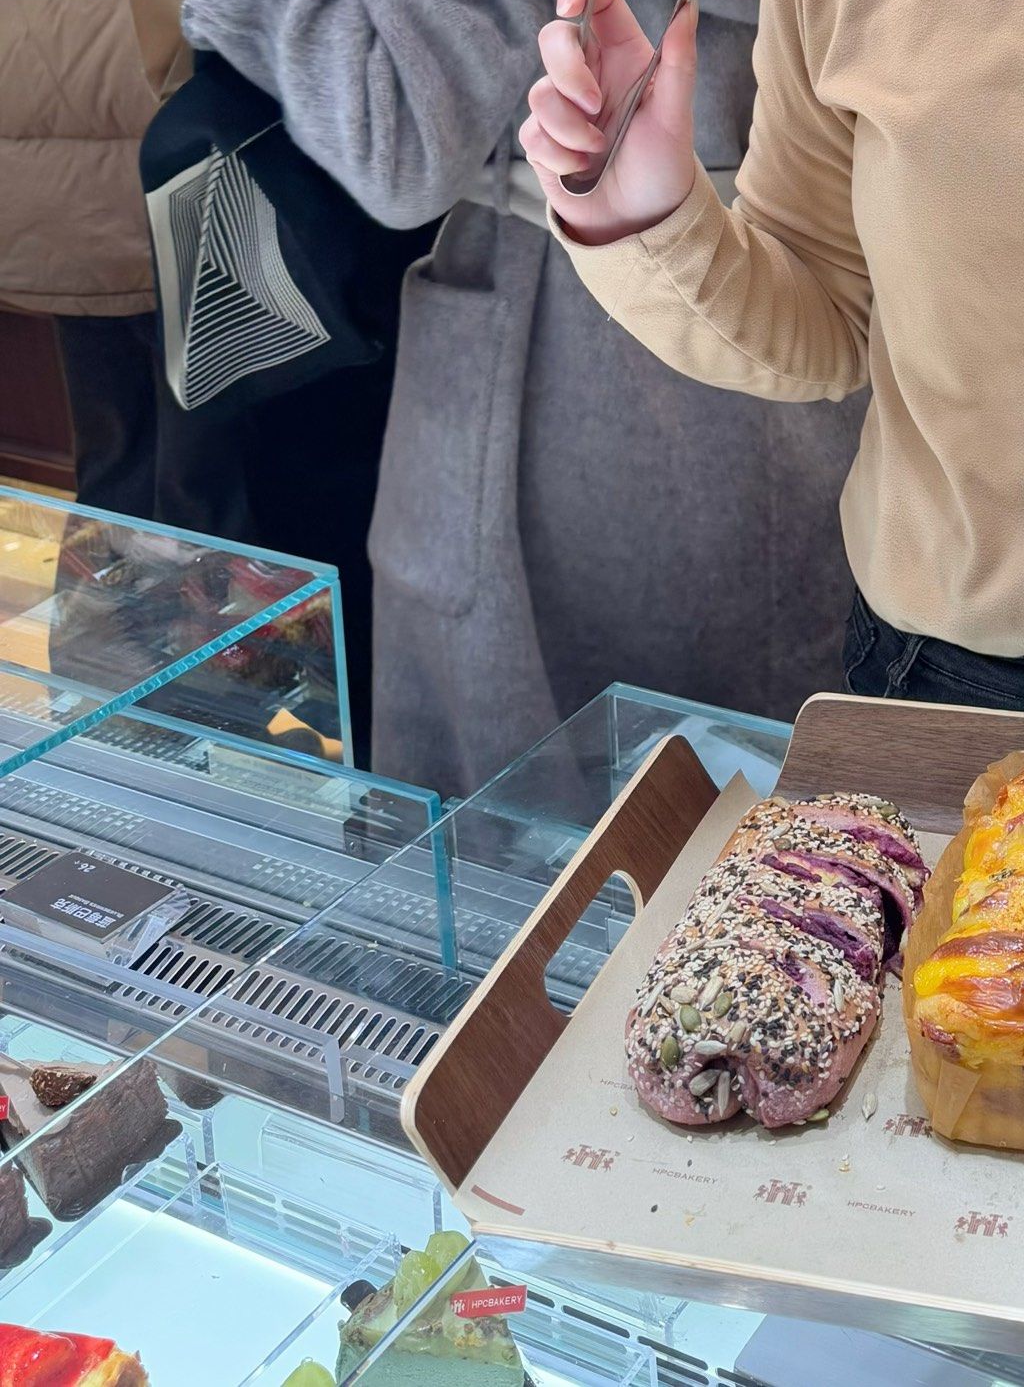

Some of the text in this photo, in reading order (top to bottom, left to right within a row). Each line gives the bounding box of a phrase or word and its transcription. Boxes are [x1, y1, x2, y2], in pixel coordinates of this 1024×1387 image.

[50, 898, 116, 929] 蓝莓巴斯克
[651, 1167, 719, 1185] HPCBAKERY
[846, 1200, 917, 1217] HPCBAKERY
[471, 1295, 523, 1309] HPCBAKERY
